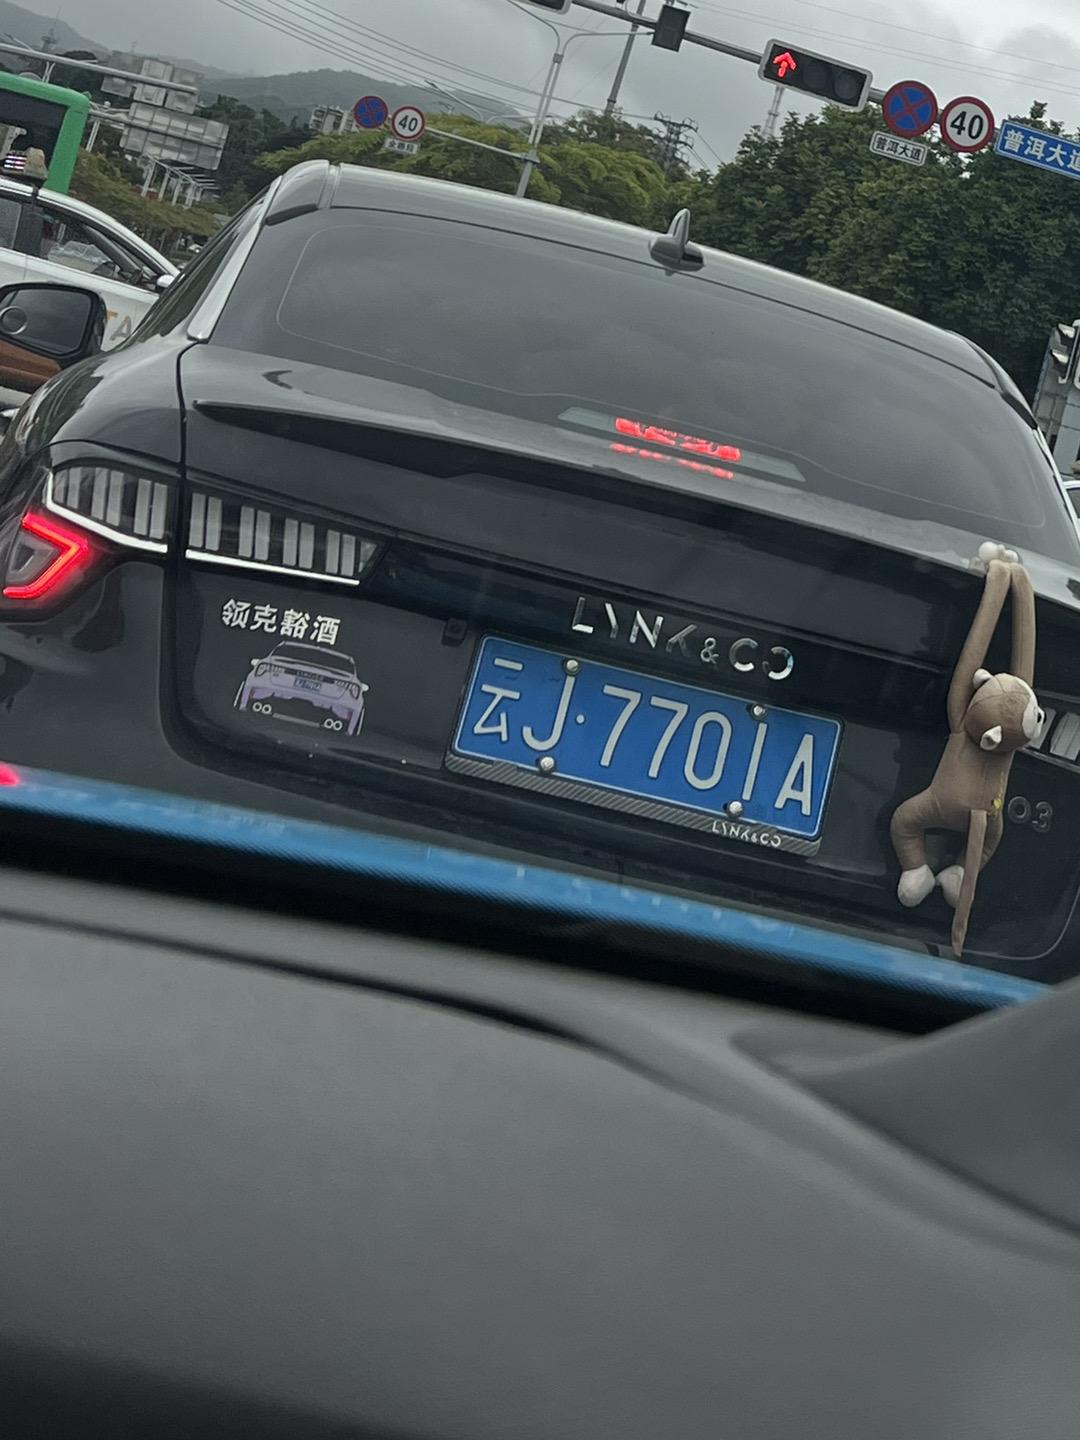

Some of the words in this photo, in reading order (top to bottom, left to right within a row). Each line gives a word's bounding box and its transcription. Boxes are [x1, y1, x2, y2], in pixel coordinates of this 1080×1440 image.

[399, 115, 418, 132] 40
[951, 111, 984, 140] 40
[875, 136, 923, 161] 普洱大道
[222, 598, 341, 645] 领克豁酒
[1008, 796, 1053, 833] 03
